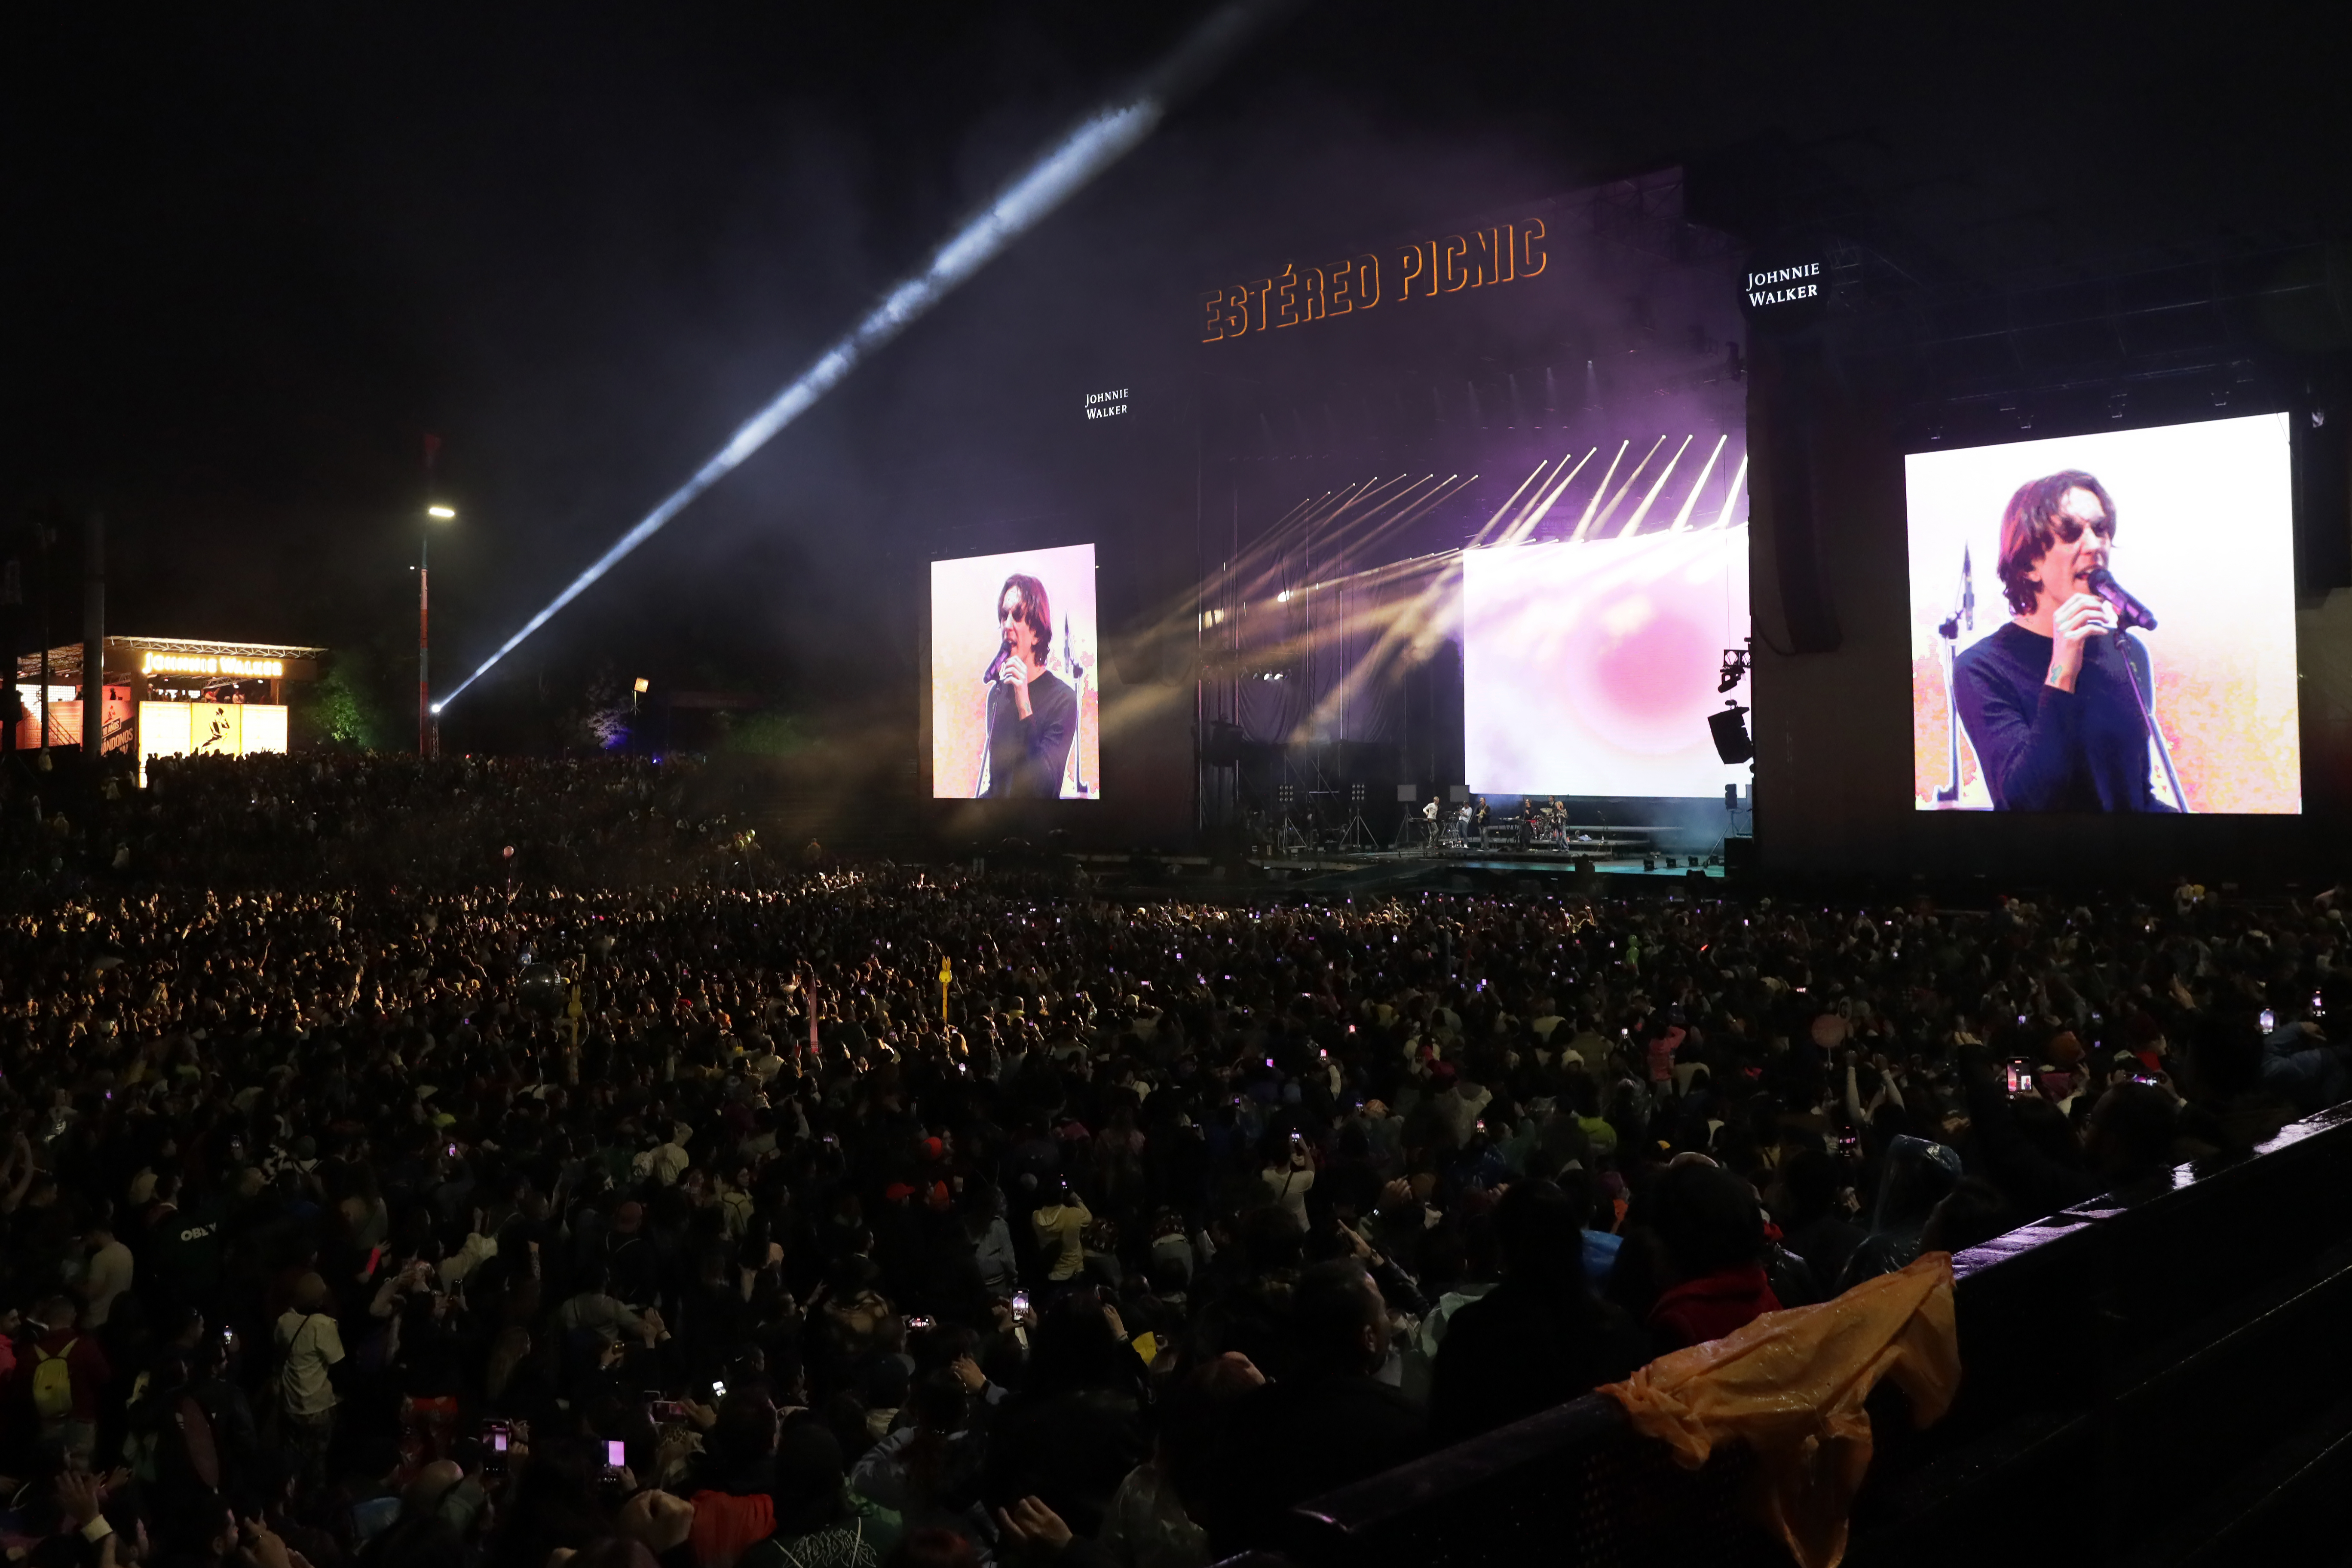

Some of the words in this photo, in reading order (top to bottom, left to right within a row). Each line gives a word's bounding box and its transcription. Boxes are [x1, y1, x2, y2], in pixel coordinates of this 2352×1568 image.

[1200, 254, 1381, 343] ESTÉREO
[1396, 218, 1547, 301] PICNIC
[1746, 263, 1820, 292] JOHNNIE
[1749, 285, 1818, 307] WALKER
[1084, 388, 1129, 408] JOHNNIE
[1086, 404, 1127, 420] WALKER
[142, 652, 217, 674] JOHNNIE
[220, 657, 283, 676] WALKER
[101, 728, 133, 756] ÁNDONOS
